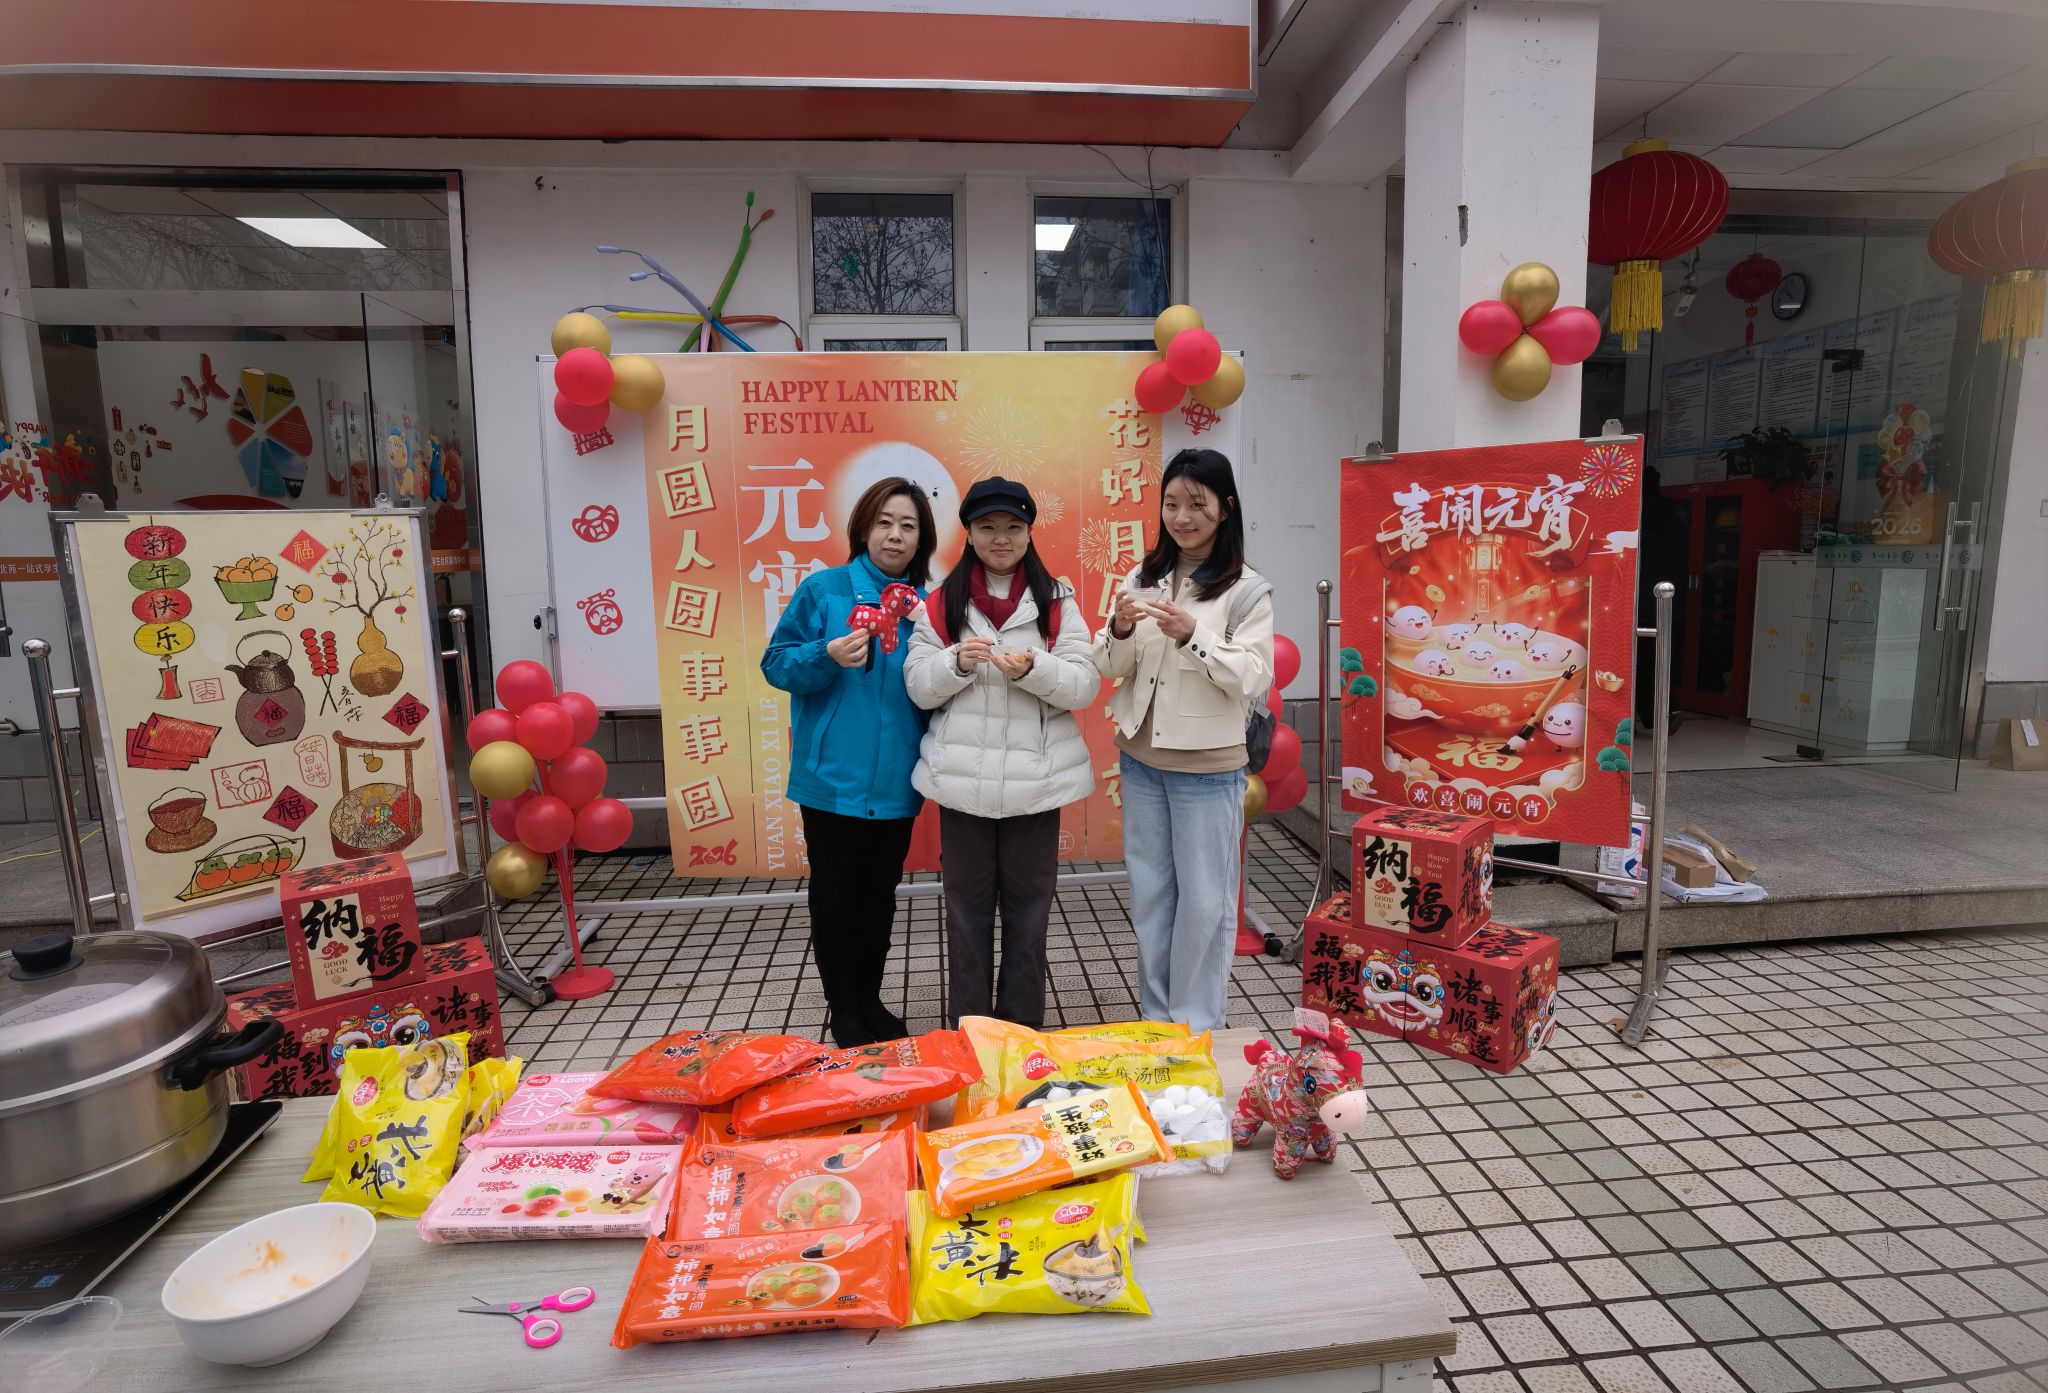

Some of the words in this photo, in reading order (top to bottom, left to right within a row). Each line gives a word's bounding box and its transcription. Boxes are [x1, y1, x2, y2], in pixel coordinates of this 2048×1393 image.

[742, 380, 828, 403] HAPPY
[838, 380, 959, 403] LANTERN
[744, 411, 874, 435] FESTIVAL
[1376, 474, 1586, 557] 喜闹元宵
[1871, 517, 1922, 536] 2026
[293, 540, 315, 563] 福
[143, 531, 181, 651] 新年快乐
[262, 707, 282, 724] 福
[395, 705, 420, 727] 福
[759, 697, 779, 723] LE
[762, 727, 781, 753] XI
[1436, 736, 1523, 771] 福
[763, 759, 783, 811] XIAO
[277, 795, 306, 821] 福
[1413, 785, 1541, 818] 欢喜闹元宵
[688, 839, 738, 868] 2026
[766, 816, 786, 873] YUAN
[1427, 852, 1451, 864] Happy
[1427, 862, 1442, 870] New
[1427, 871, 1443, 880] Year
[379, 893, 405, 904] Happy
[380, 903, 398, 912] New
[1374, 894, 1394, 904] GOOD
[1374, 902, 1393, 911] LUCK
[382, 911, 401, 921] Year
[323, 958, 349, 969] GOOD
[324, 966, 349, 977] LUCK
